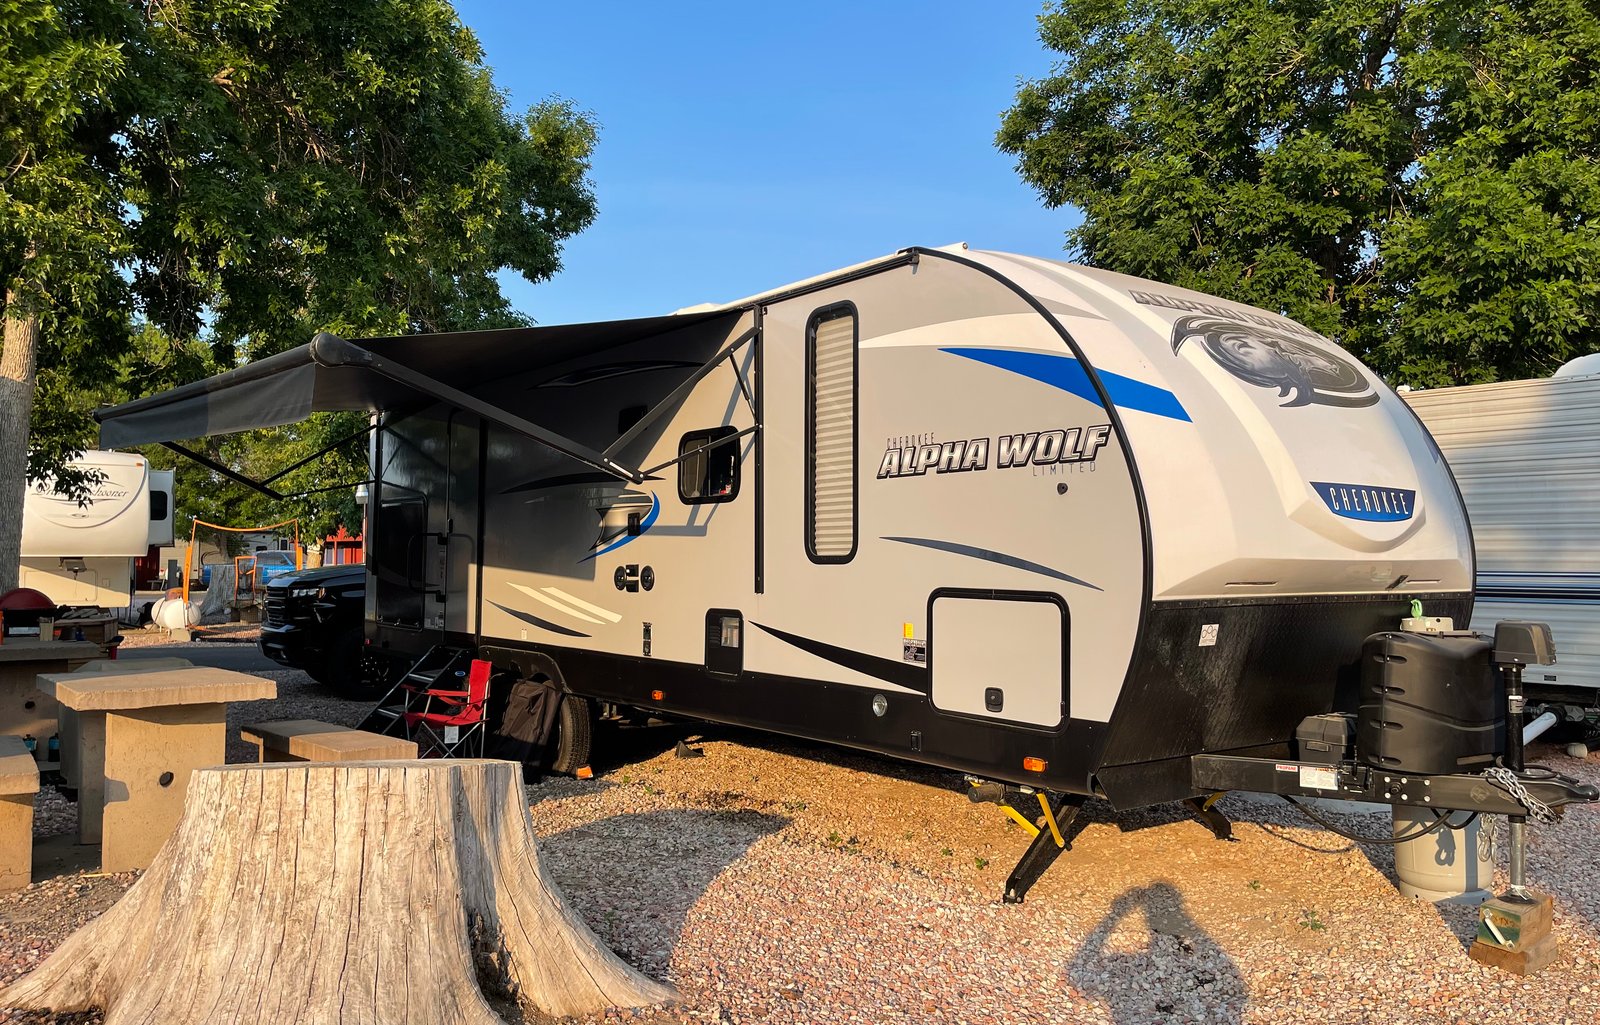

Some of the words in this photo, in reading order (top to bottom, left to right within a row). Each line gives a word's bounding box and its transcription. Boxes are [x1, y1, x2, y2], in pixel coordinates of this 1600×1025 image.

[877, 437, 990, 479] ALPHA
[997, 424, 1112, 469] WOLF
[887, 432, 935, 450] CHEROKEE
[1032, 461, 1096, 477] LIMITED
[1329, 487, 1409, 515] CHEROKEE
